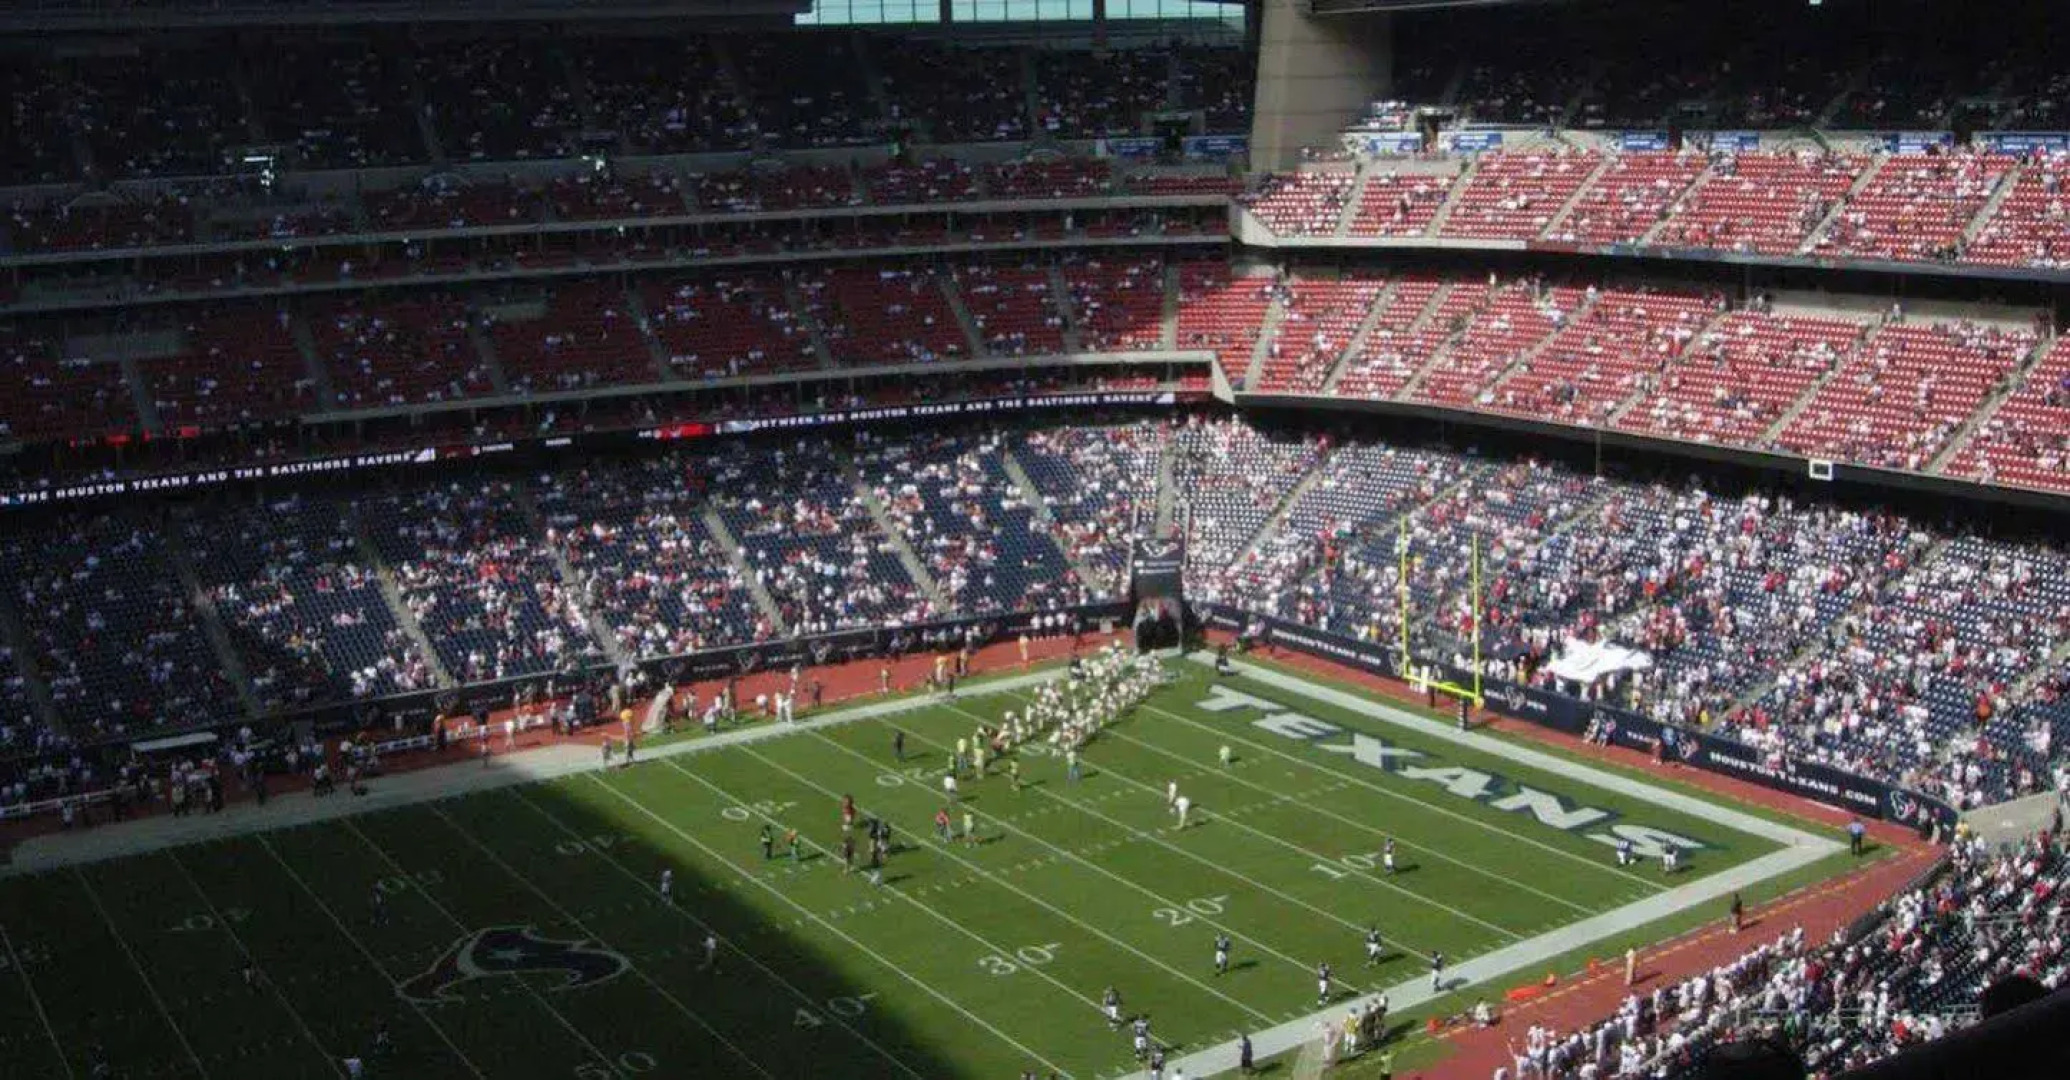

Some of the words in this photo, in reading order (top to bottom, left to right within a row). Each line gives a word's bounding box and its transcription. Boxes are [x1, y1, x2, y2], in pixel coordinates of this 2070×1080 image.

[850, 408, 908, 421] HOUSTON
[913, 403, 960, 415] TEXANS
[966, 401, 991, 411] AND
[999, 400, 1021, 409] THE
[1027, 396, 1097, 408] BALTIMORE
[18, 491, 48, 503] THE
[56, 483, 124, 499] HOUSTON
[132, 475, 190, 490] TEXANS
[197, 471, 228, 482] AND
[234, 467, 263, 478] THE
[271, 459, 350, 476] BALTIMORE
[1194, 683, 1706, 857] TEXANS
[1152, 897, 1225, 927] 20
[978, 945, 1054, 975] 30
